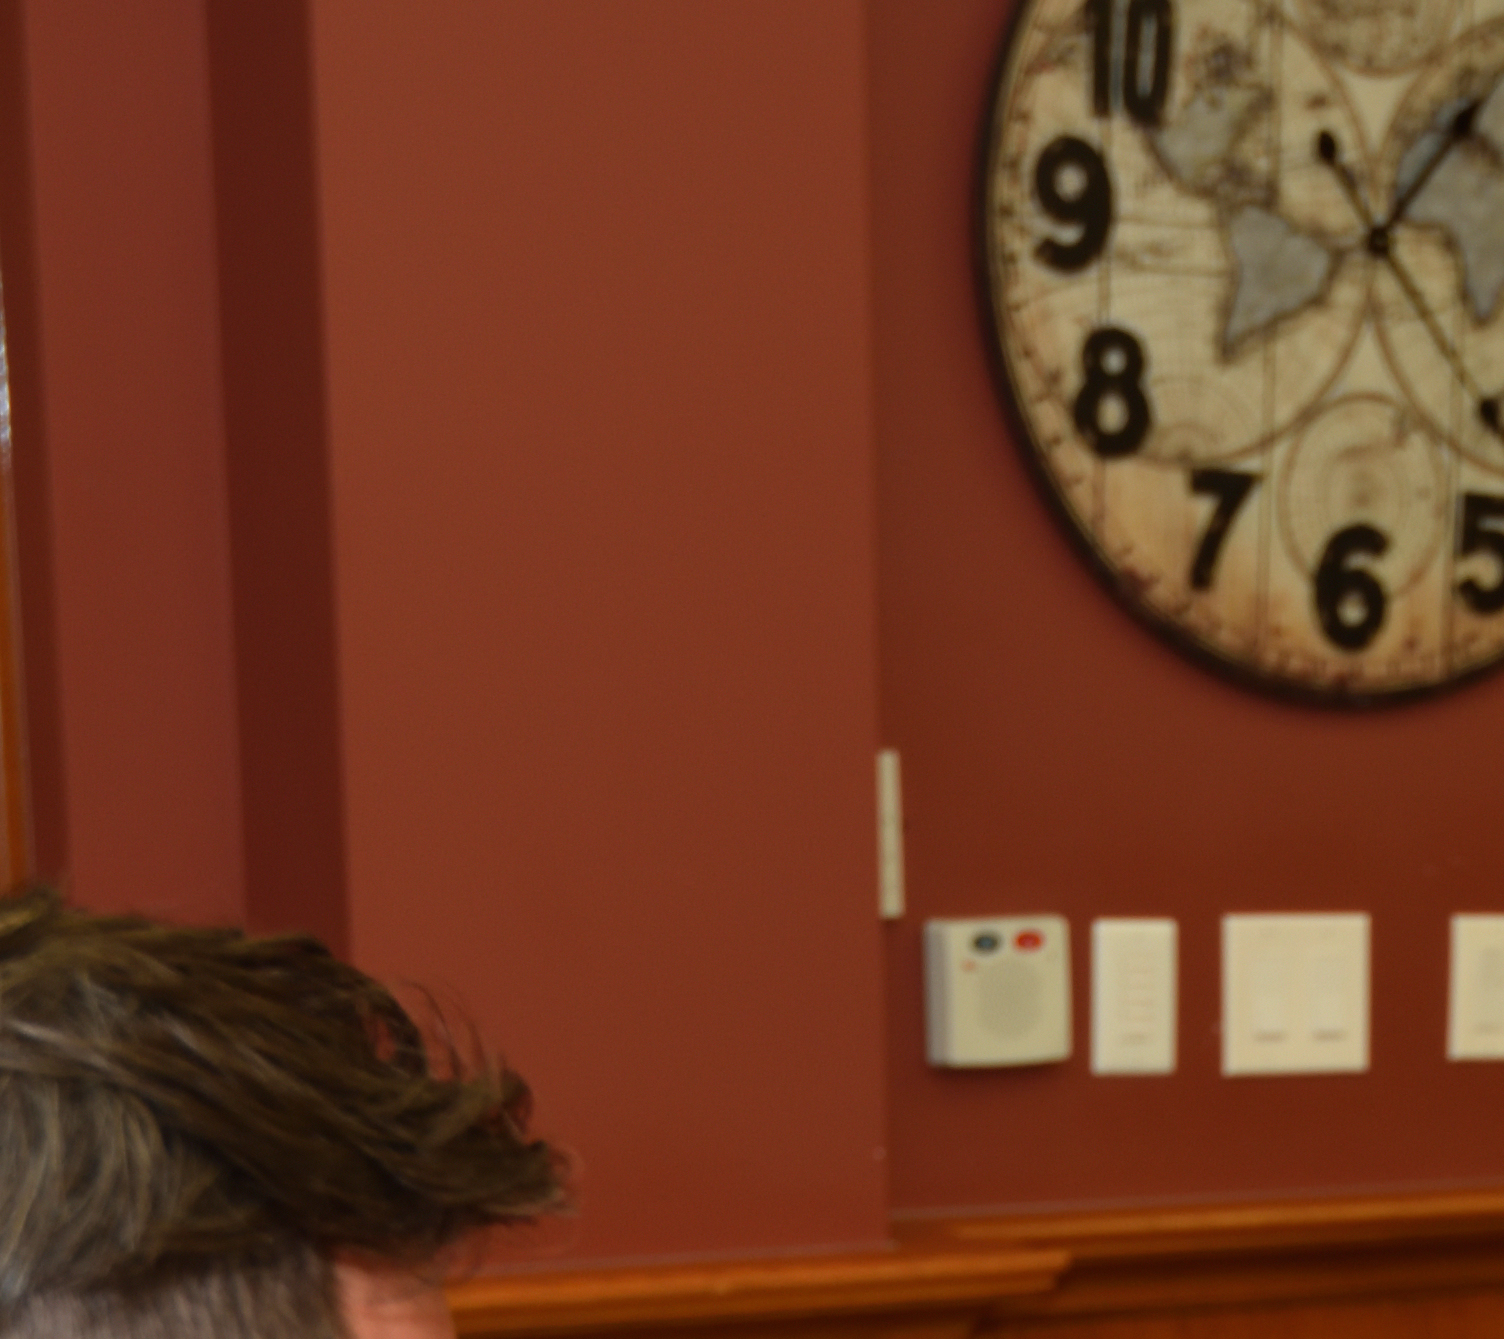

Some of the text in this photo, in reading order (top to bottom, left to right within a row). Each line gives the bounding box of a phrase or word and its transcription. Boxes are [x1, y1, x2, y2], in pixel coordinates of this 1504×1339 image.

[1090, 0, 1174, 128] 10
[1034, 135, 1113, 273] 9
[1073, 327, 1151, 456] 8
[1188, 467, 1264, 592] 7
[1314, 521, 1390, 651] 6
